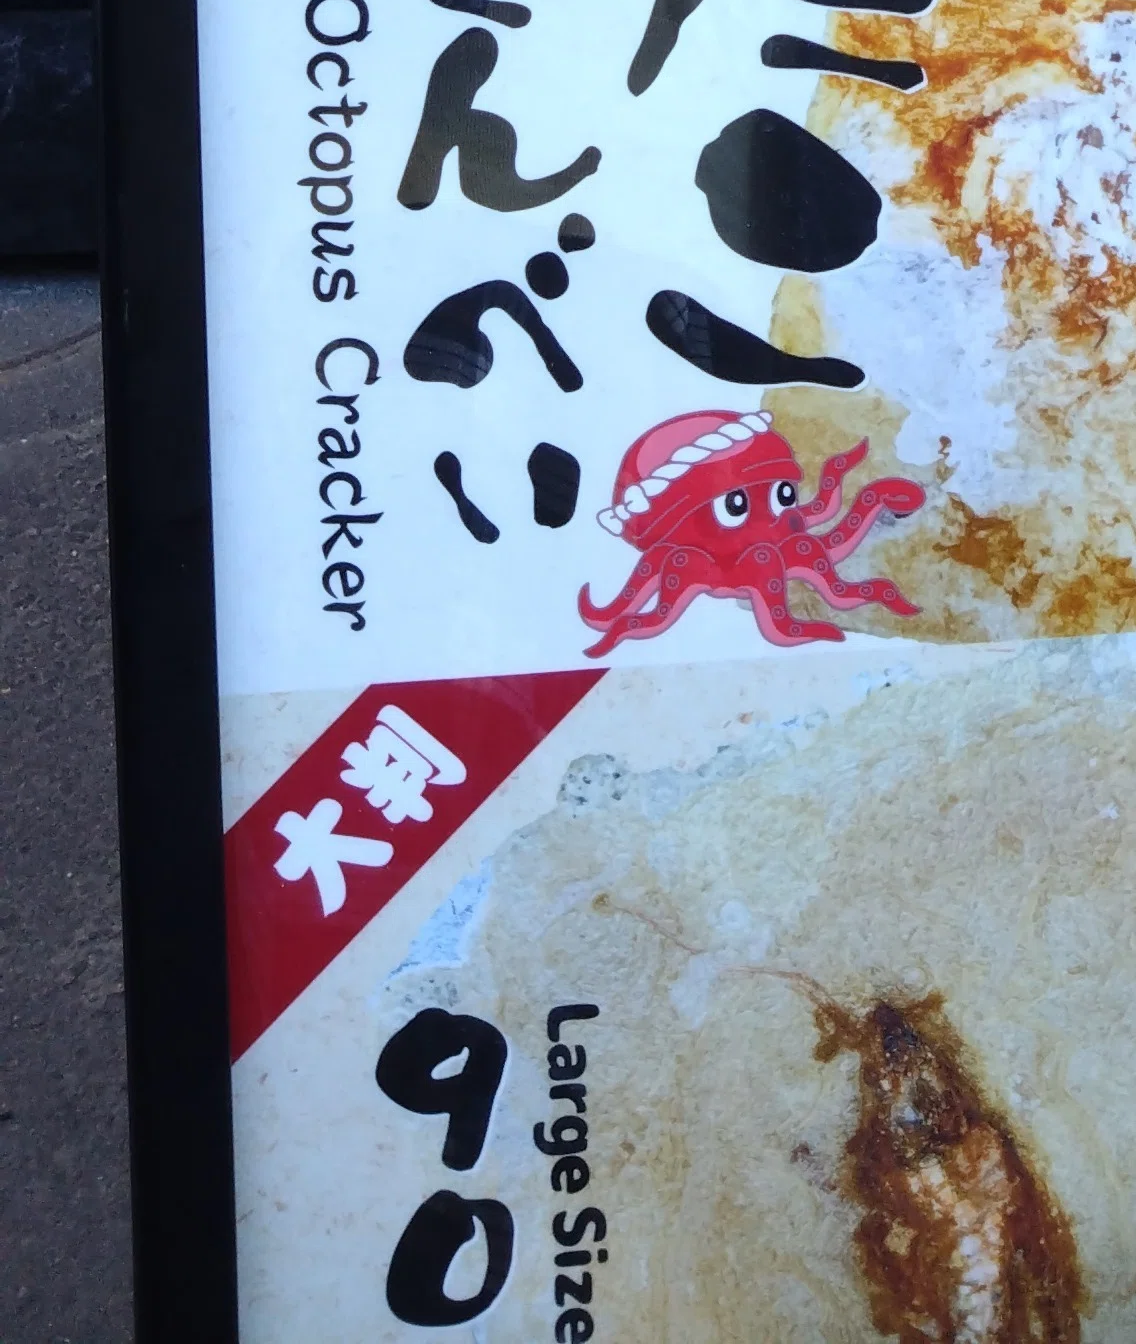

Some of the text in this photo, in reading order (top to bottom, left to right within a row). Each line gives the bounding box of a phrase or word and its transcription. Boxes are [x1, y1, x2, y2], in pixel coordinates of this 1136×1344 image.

[313, 337, 386, 632] Cracker
[272, 705, 467, 917] 大判
[375, 1007, 515, 1326] 90
[533, 1004, 608, 1344] Large Size
